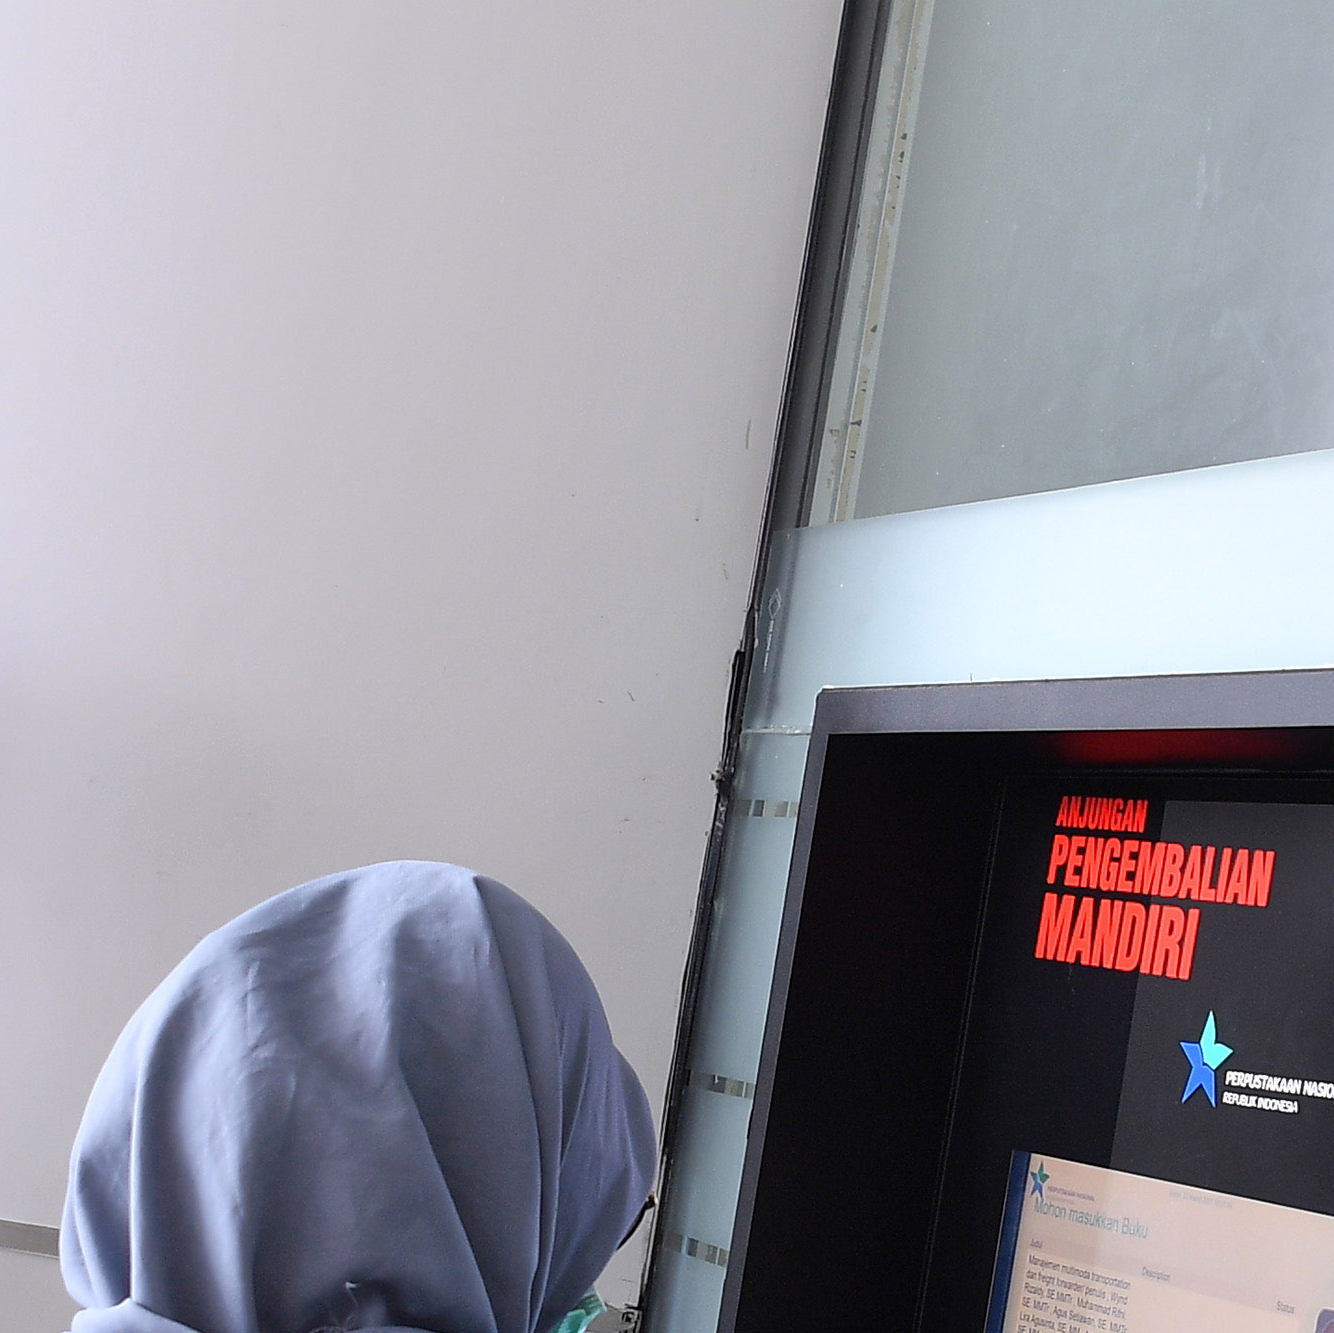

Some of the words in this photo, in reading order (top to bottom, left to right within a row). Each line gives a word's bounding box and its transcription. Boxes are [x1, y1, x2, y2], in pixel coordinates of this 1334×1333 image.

[1055, 795, 1149, 833] ANJUNGAN
[1047, 834, 1275, 907] PENGEMBALIAN
[1035, 893, 1201, 980] MANDIRI
[1222, 1092, 1257, 1107] REPUBLIK
[1257, 1097, 1299, 1113] INDONESIA
[1225, 1070, 1302, 1095] PERPUSTAKAAN
[1034, 1197, 1066, 1218] Mohon
[1069, 1208, 1119, 1232] masukkan
[1121, 1217, 1148, 1239] Buku
